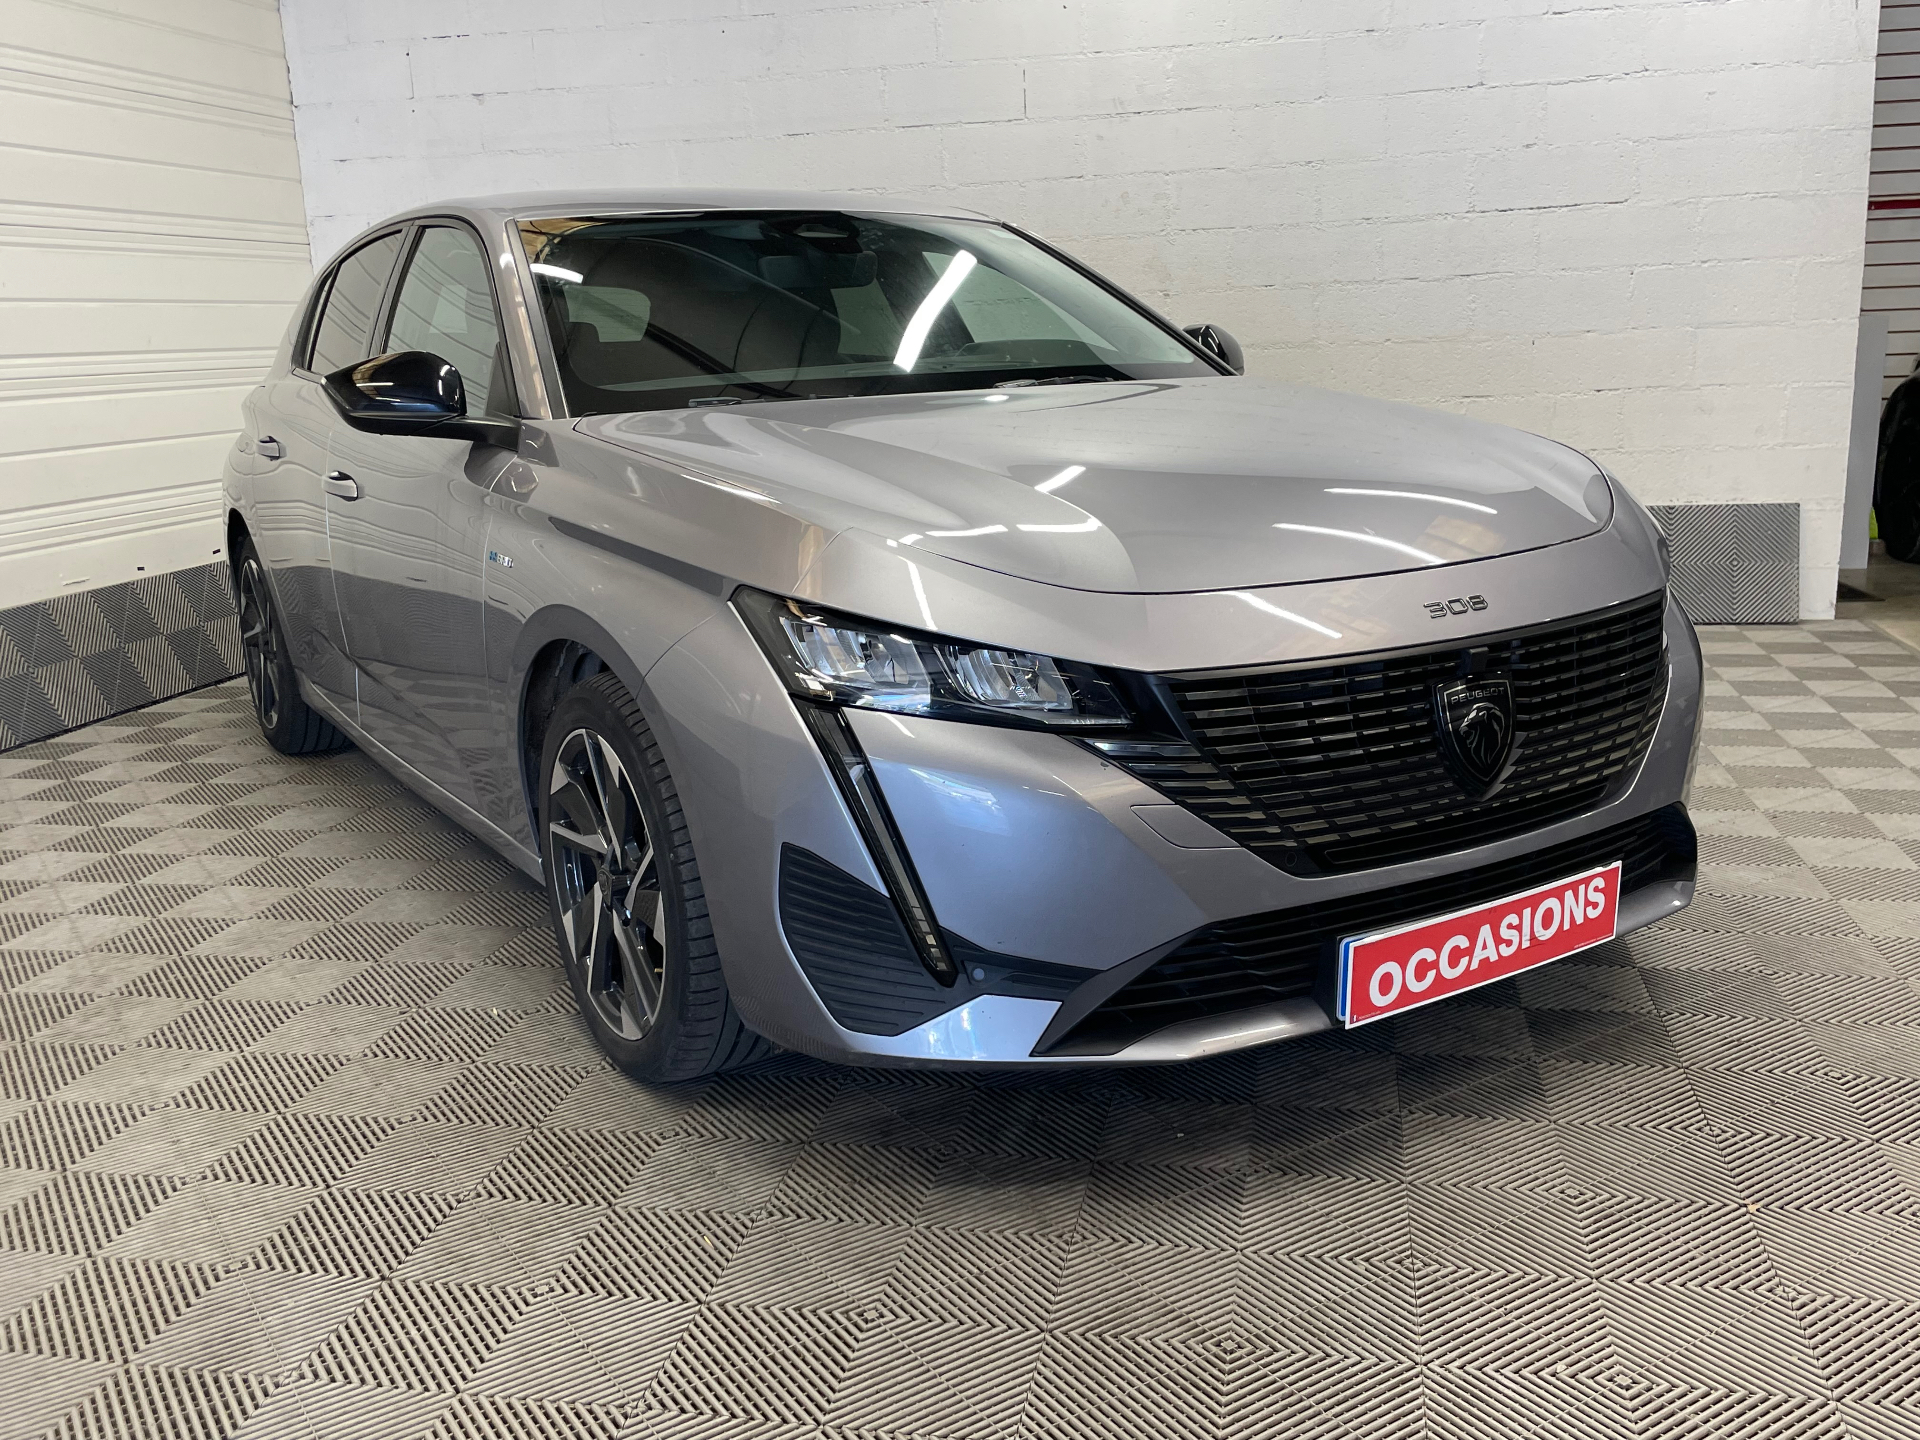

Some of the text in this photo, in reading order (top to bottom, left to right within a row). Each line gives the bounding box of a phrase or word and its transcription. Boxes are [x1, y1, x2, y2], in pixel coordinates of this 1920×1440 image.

[1423, 594, 1488, 619] 308
[1451, 687, 1505, 704] PEUGEOT
[1368, 876, 1606, 1008] OCCASIONS
